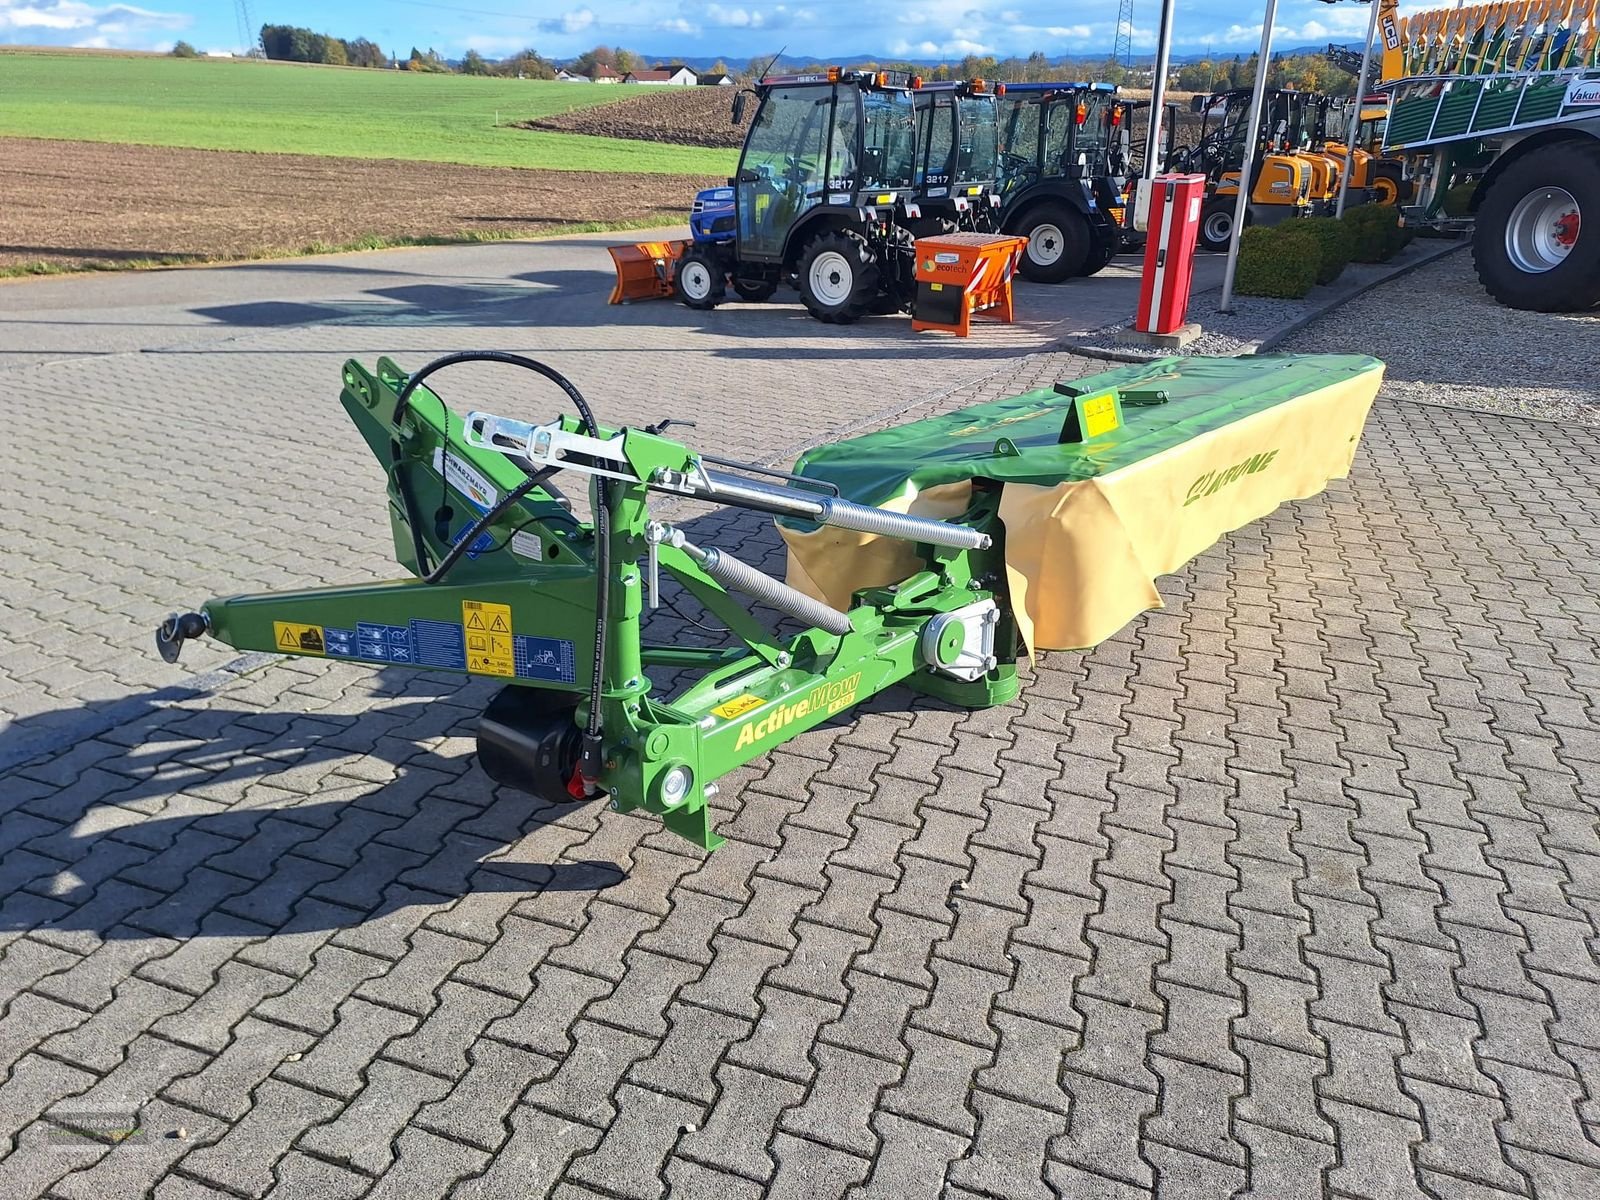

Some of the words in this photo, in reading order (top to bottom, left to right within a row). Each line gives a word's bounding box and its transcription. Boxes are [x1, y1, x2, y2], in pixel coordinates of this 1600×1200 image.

[1382, 16, 1399, 50] JCB
[1570, 88, 1600, 104] Vakut
[829, 180, 854, 190] 3217
[926, 175, 949, 184] 3217
[936, 264, 968, 274] ecotech
[440, 449, 488, 496] CHWARZMAYR
[1203, 448, 1280, 497] KRONE
[734, 671, 861, 752] ActiveMow
